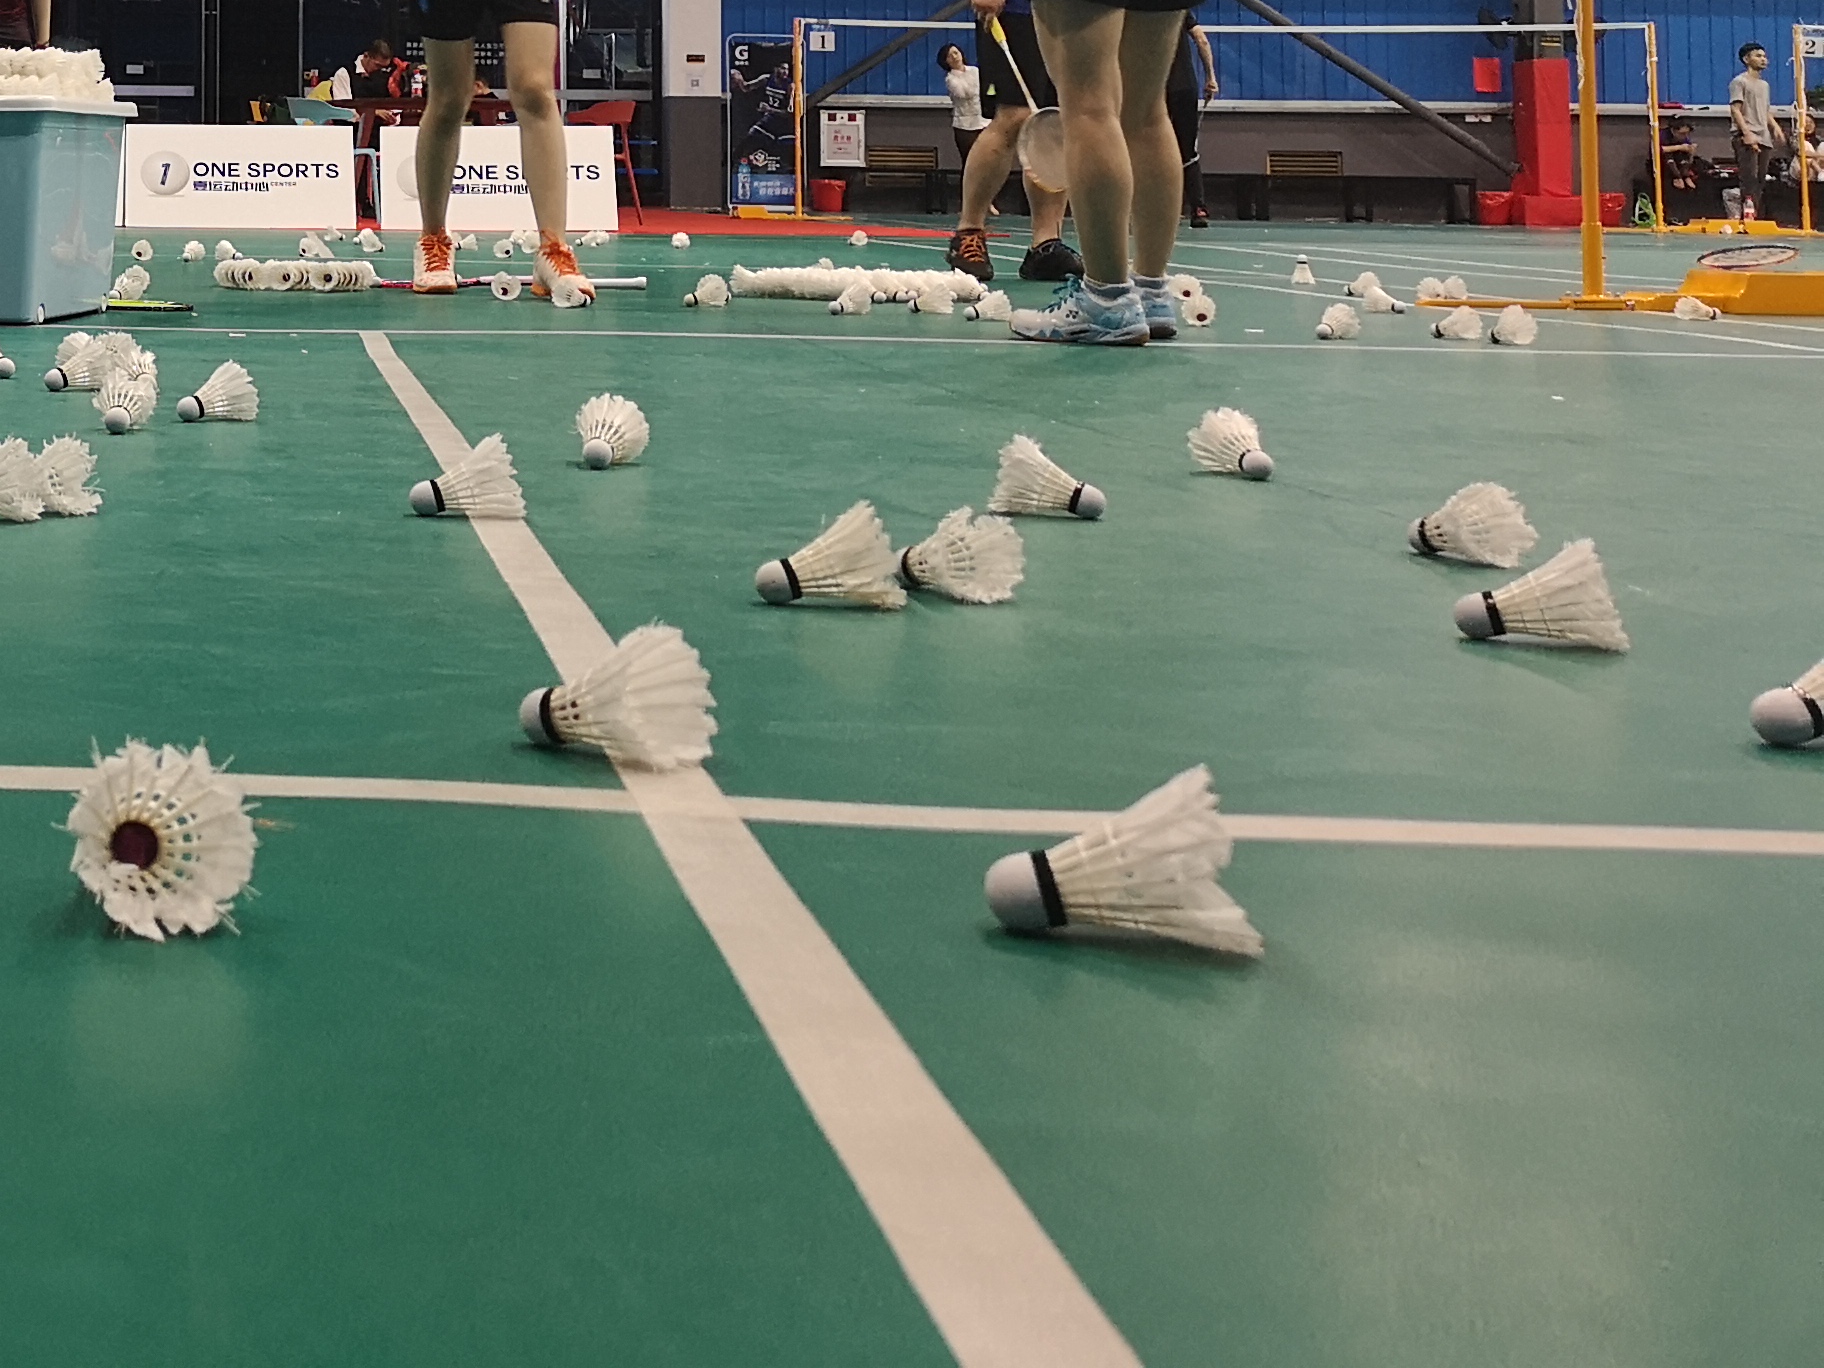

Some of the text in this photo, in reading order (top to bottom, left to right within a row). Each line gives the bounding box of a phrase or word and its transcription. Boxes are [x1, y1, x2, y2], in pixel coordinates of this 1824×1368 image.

[819, 34, 826, 50] 1
[1804, 39, 1816, 55] 2
[734, 45, 749, 60] G
[193, 162, 339, 179] ONE SPORTS
[452, 165, 498, 180] ONE
